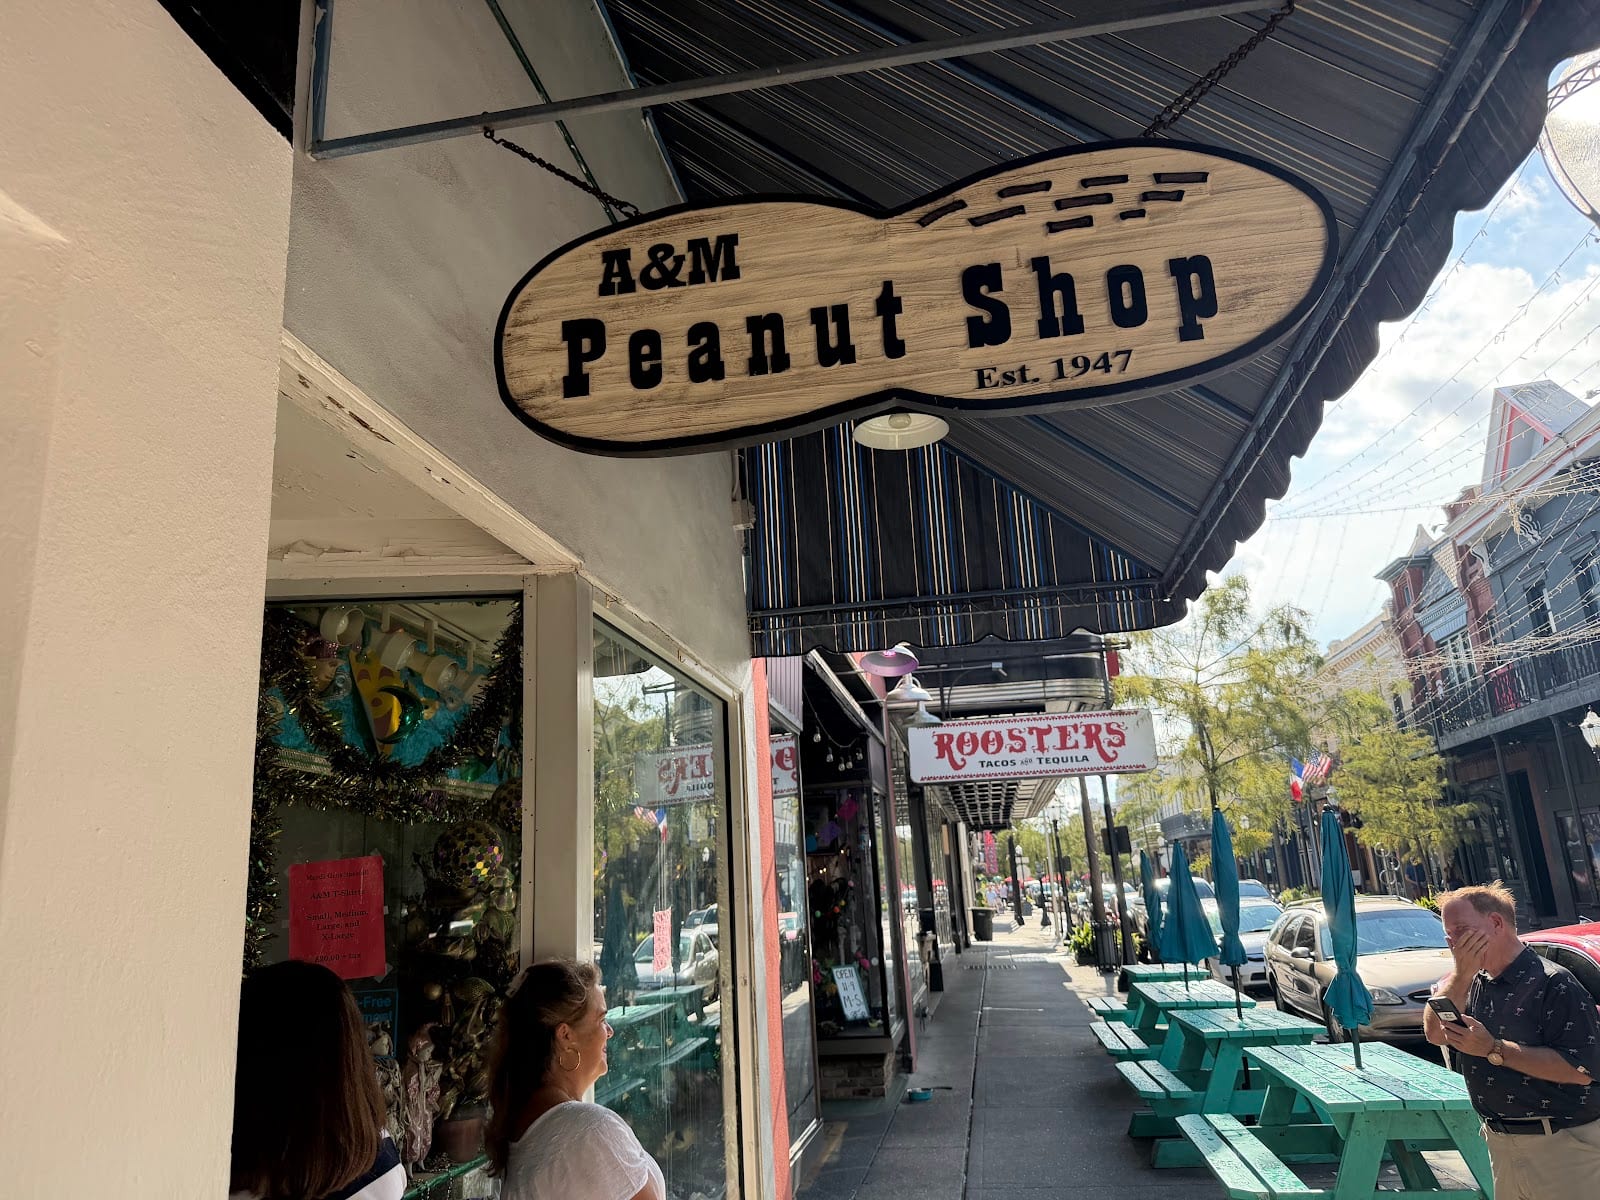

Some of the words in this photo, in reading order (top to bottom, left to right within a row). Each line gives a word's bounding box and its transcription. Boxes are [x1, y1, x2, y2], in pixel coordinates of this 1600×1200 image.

[599, 233, 741, 296] A&M
[562, 280, 906, 399] Peanut
[961, 254, 1219, 349] Shop
[975, 363, 1042, 392] Est.
[1051, 349, 1134, 382] 1947
[932, 721, 1128, 771] ROOSTERS
[979, 759, 1017, 768] TACOS
[1036, 755, 1090, 765] TEQUILA
[835, 968, 854, 979] OPEN
